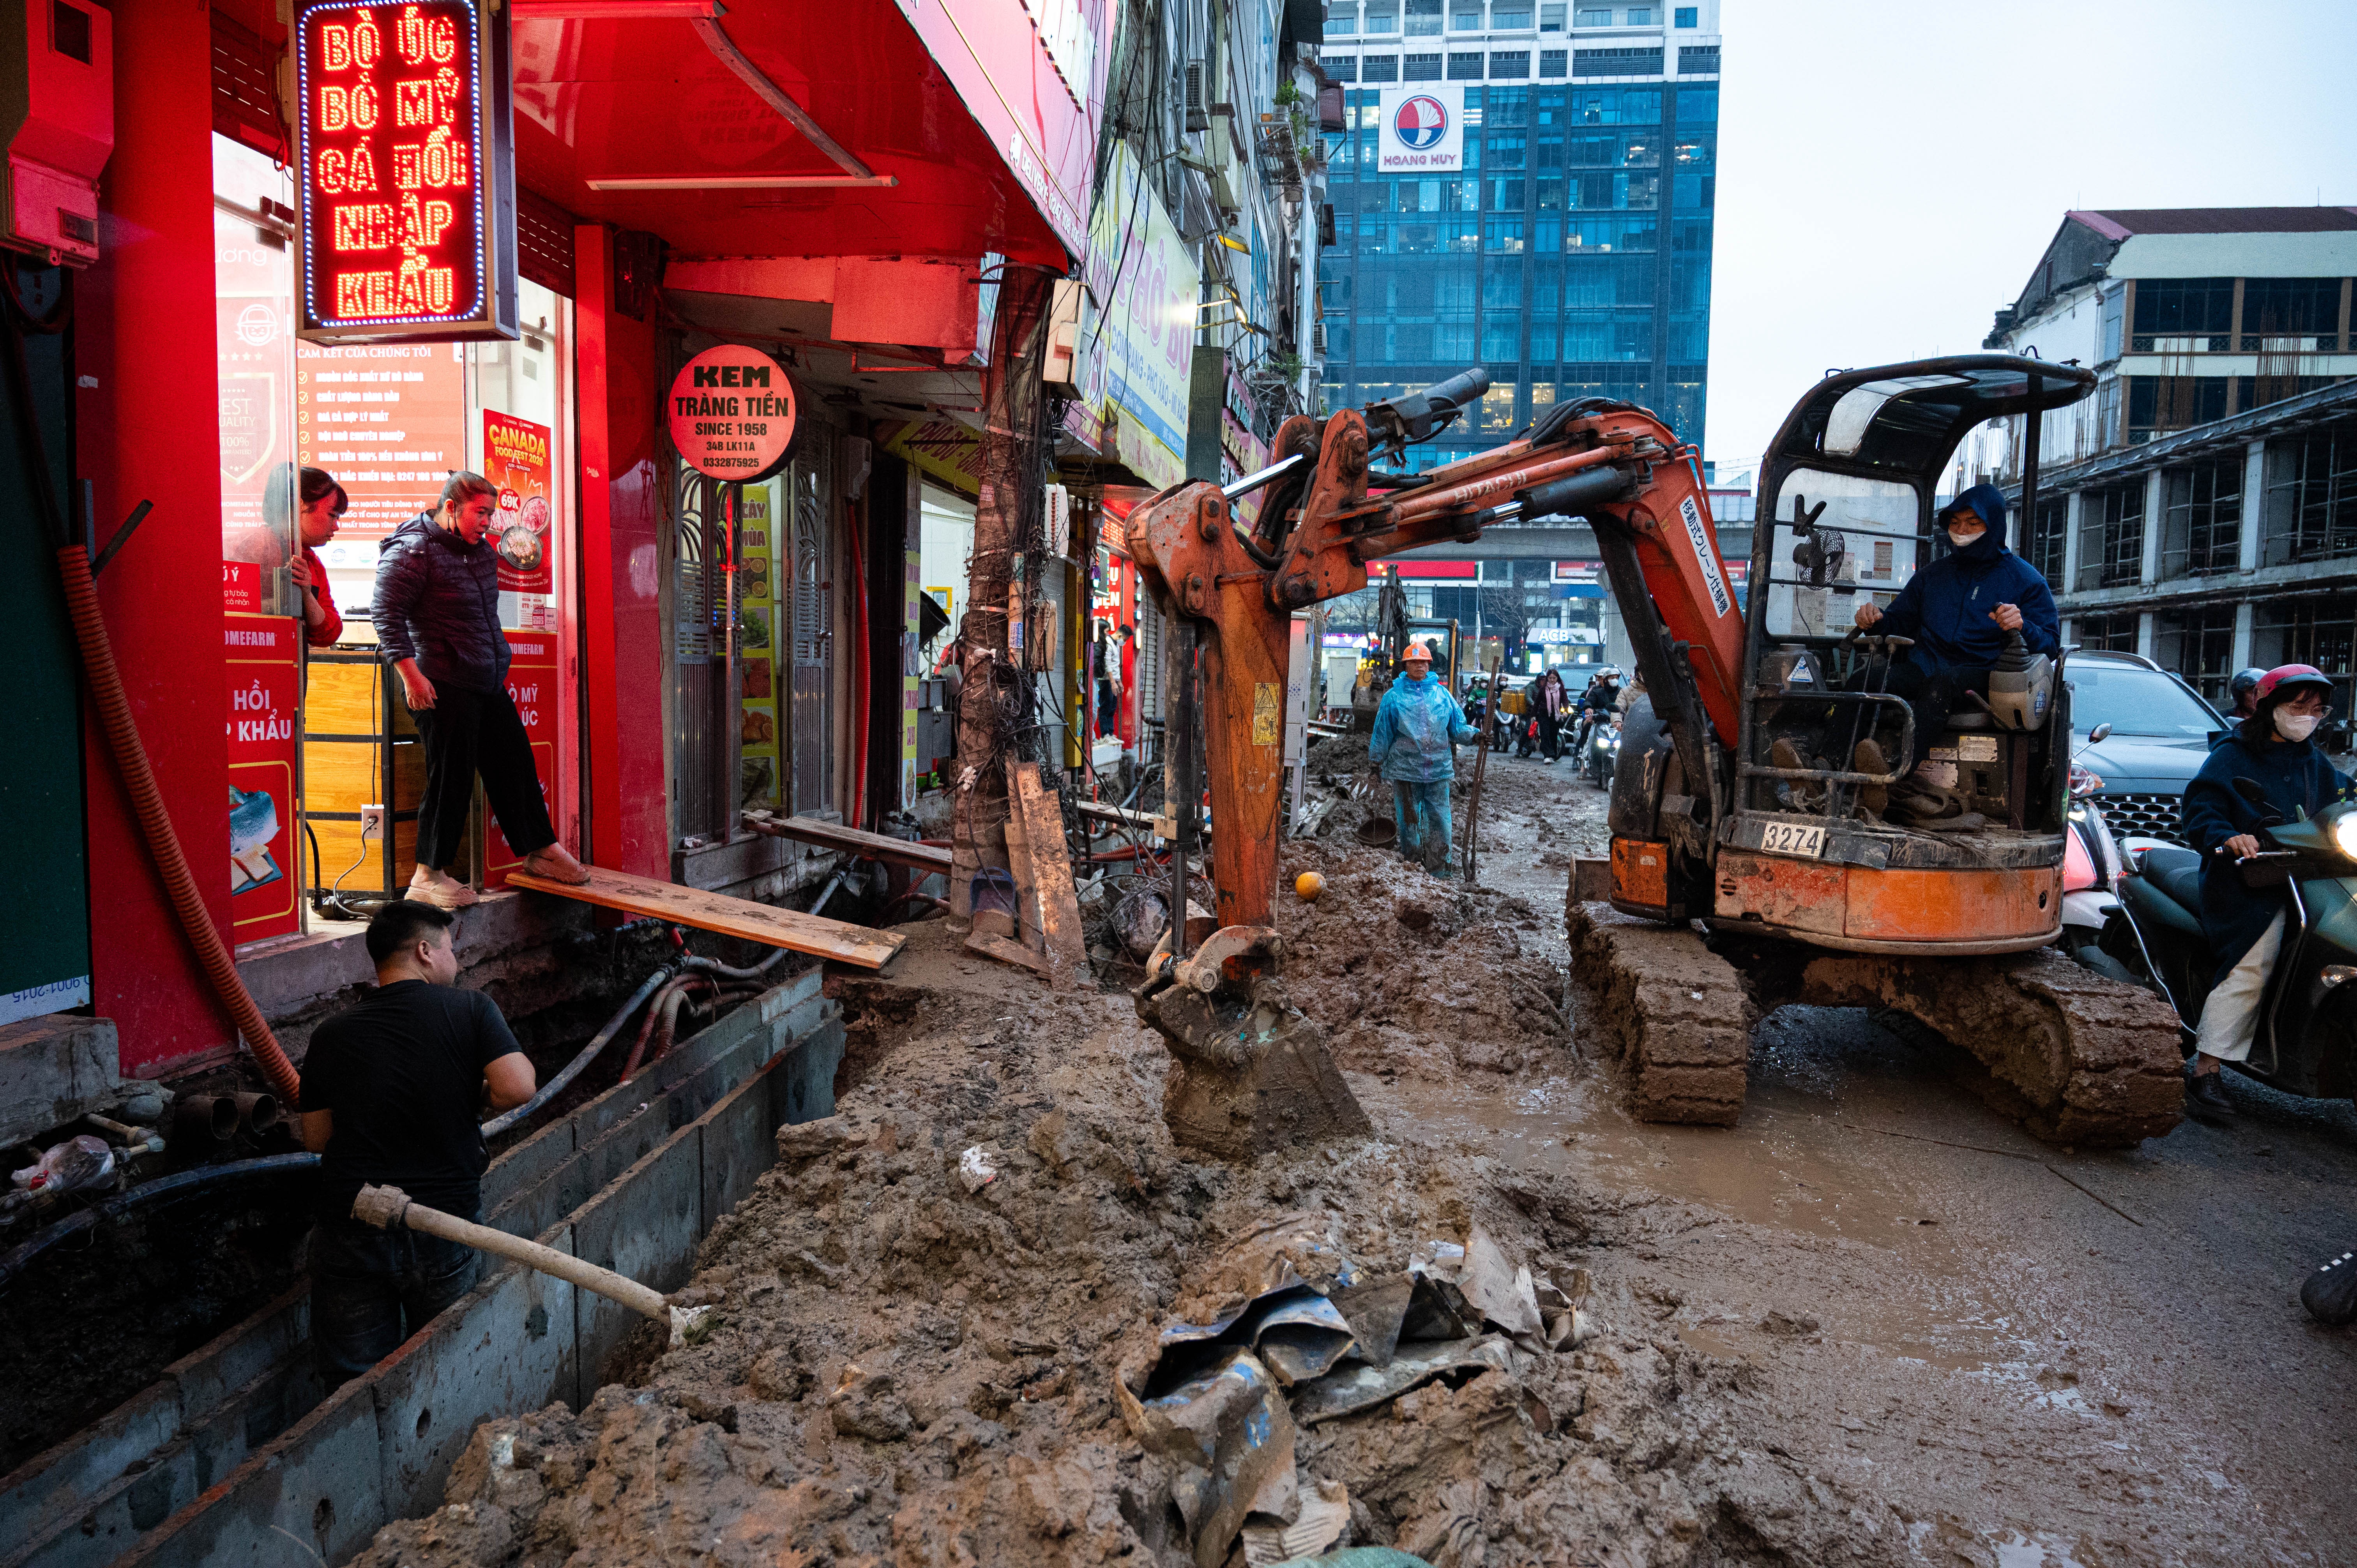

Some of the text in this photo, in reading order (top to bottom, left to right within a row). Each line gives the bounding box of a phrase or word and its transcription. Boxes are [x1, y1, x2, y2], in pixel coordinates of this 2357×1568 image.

[319, 135, 378, 194] CÁ
[1384, 155, 1456, 165] HOANG HUY
[1021, 150, 1049, 205] DELIVERY:
[1049, 192, 1061, 222] 0247
[1061, 210, 1071, 235] 108
[337, 254, 453, 318] KHẨU
[1117, 216, 1167, 346] PHỞ
[297, 345, 431, 358] CAM KẾT CỦA CHÚNG TÔI
[694, 366, 770, 388] KEM
[1111, 324, 1127, 364] CƠM
[1127, 341, 1143, 380] RANG
[1147, 363, 1158, 395] PHỞ
[1158, 374, 1169, 407] XÀO
[1177, 395, 1186, 426] XÀO
[219, 398, 252, 415] EST
[675, 391, 788, 417] TRÀNG TIỀN
[219, 417, 256, 427] UALITY
[695, 423, 767, 436] SINCE 1958
[221, 436, 249, 447] 100%
[489, 424, 546, 458] CANADA
[706, 441, 755, 451] 34B LK11A
[495, 446, 543, 467] FOOD FEST 2026
[703, 458, 759, 467] 0332875925
[397, 472, 415, 481] 0247
[1454, 471, 1527, 503] HITACHI
[360, 500, 378, 508] NGƯỜI
[394, 500, 410, 508] DÙNG
[412, 500, 426, 509] VIỆT
[501, 494, 519, 509] 69K
[341, 510, 355, 518] UỐC
[357, 510, 364, 518] TẾ
[341, 520, 357, 528] NHẤT
[1682, 499, 1728, 614] 移動式クレーン仕様機
[1538, 629, 1569, 643] ACB
[234, 678, 269, 711] HỒI
[508, 683, 538, 703] Ò MỸ
[239, 709, 291, 742] KHẨU
[522, 706, 538, 726] ÚC
[1765, 826, 1819, 854] 3274
